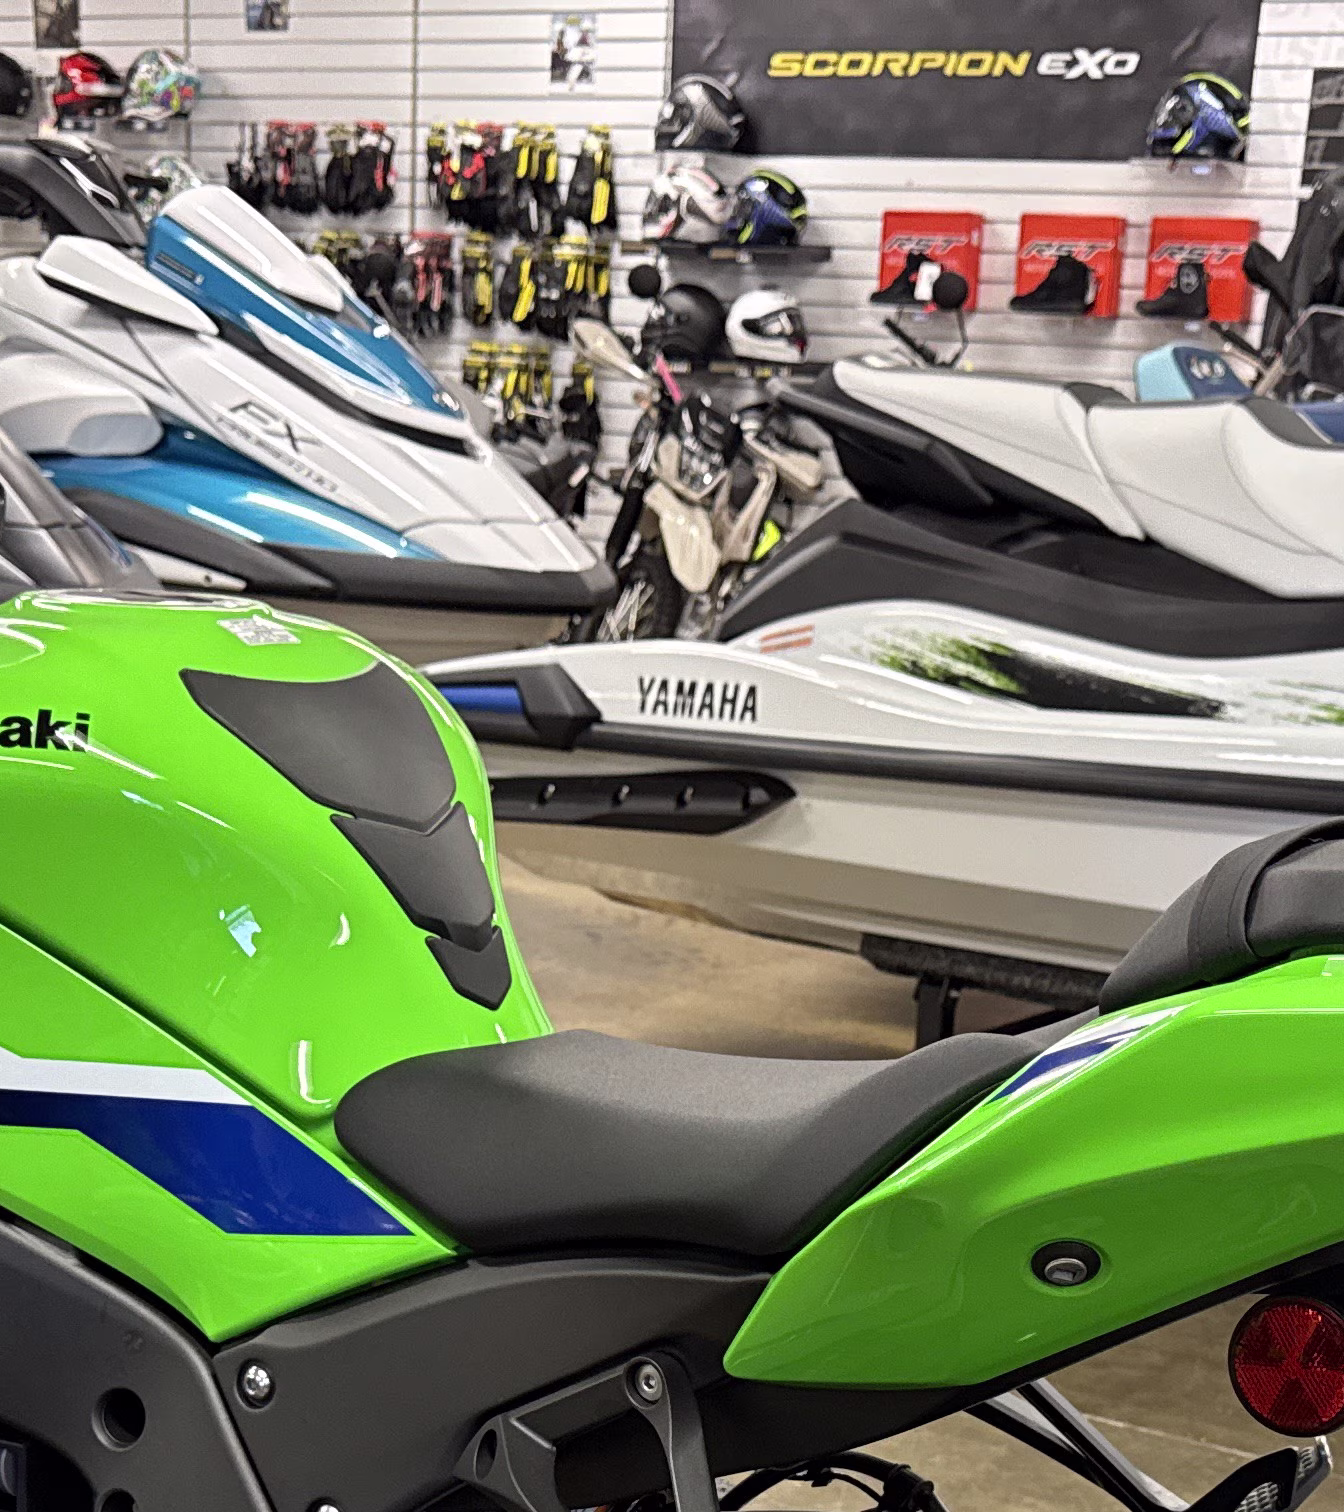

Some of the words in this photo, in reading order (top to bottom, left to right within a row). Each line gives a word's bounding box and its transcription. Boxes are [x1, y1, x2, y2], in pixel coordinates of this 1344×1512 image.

[767, 50, 1033, 79] SCORPION
[1151, 240, 1251, 262] RST
[229, 400, 324, 455] FX
[637, 675, 758, 724] YAMAHA
